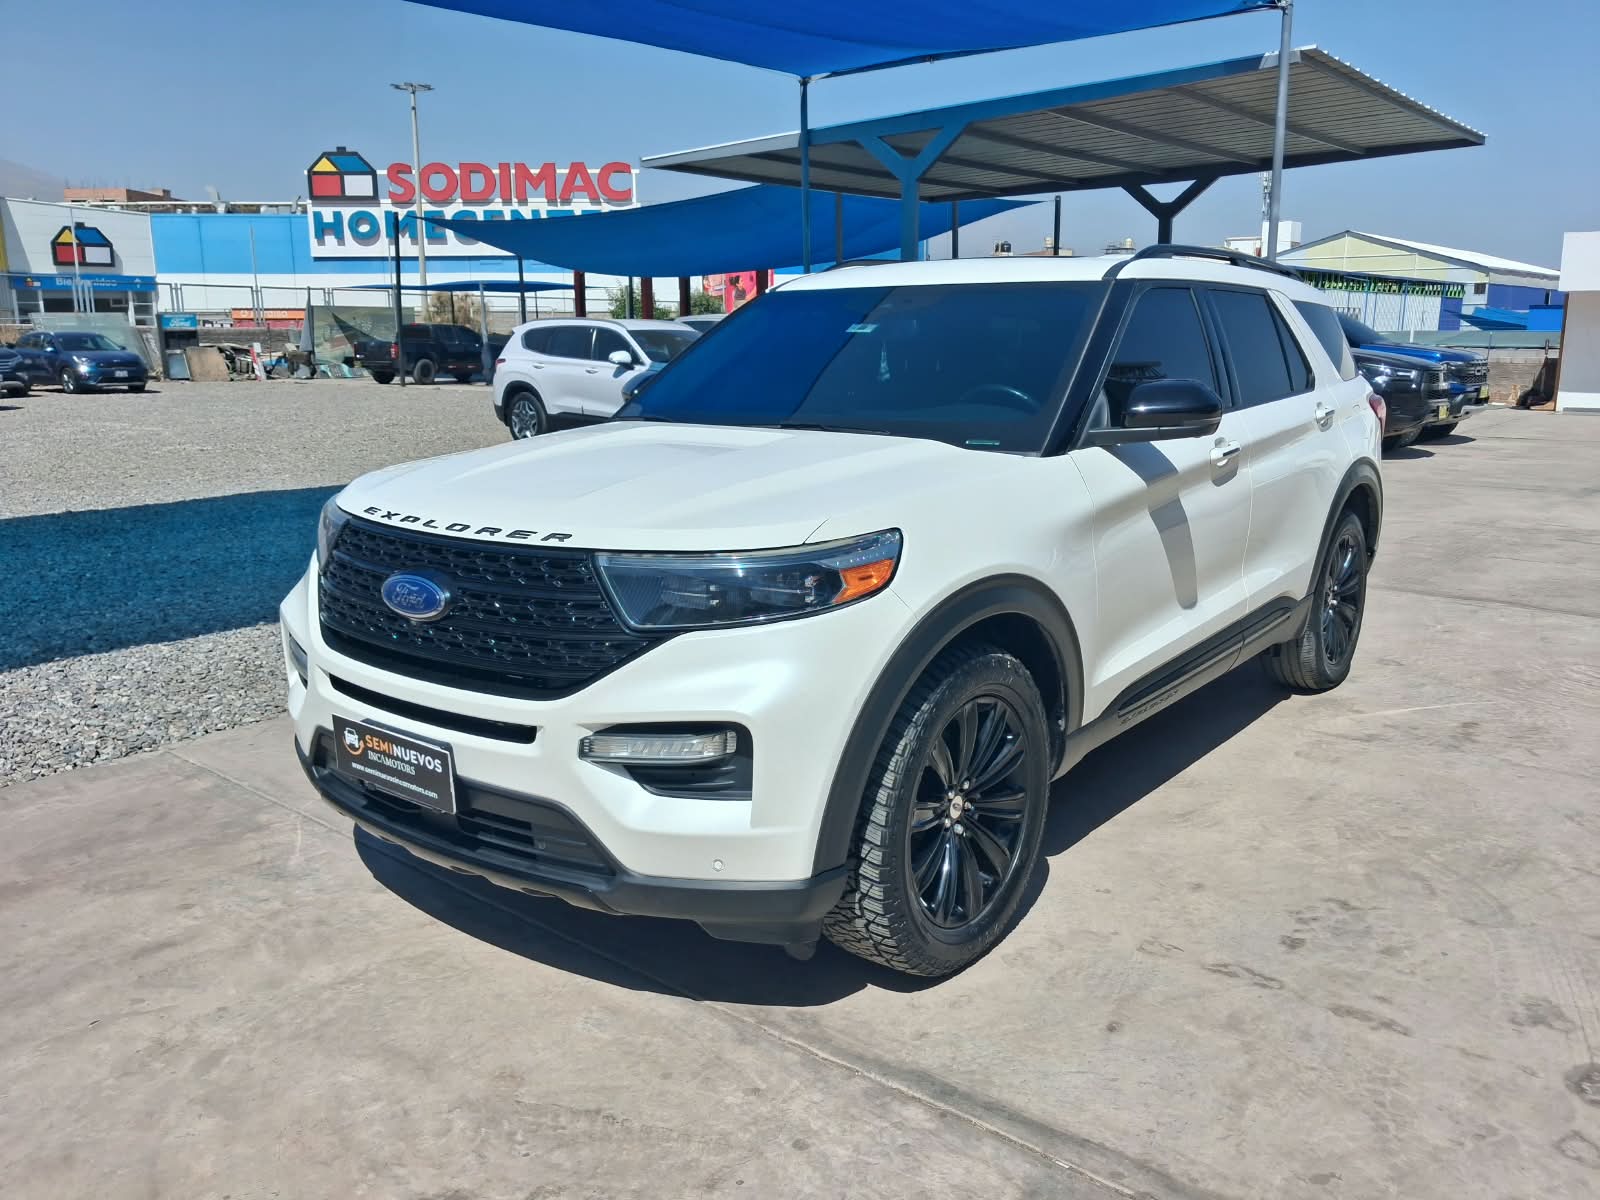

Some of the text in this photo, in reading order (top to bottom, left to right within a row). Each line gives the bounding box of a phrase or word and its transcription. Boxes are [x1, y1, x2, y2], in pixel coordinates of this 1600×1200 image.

[387, 161, 633, 203] SODIMAC
[363, 506, 573, 542] EXPLORER
[391, 582, 426, 609] Ford
[365, 734, 442, 773] SEMINUEVOS
[367, 750, 416, 776] INCAMOTORS
